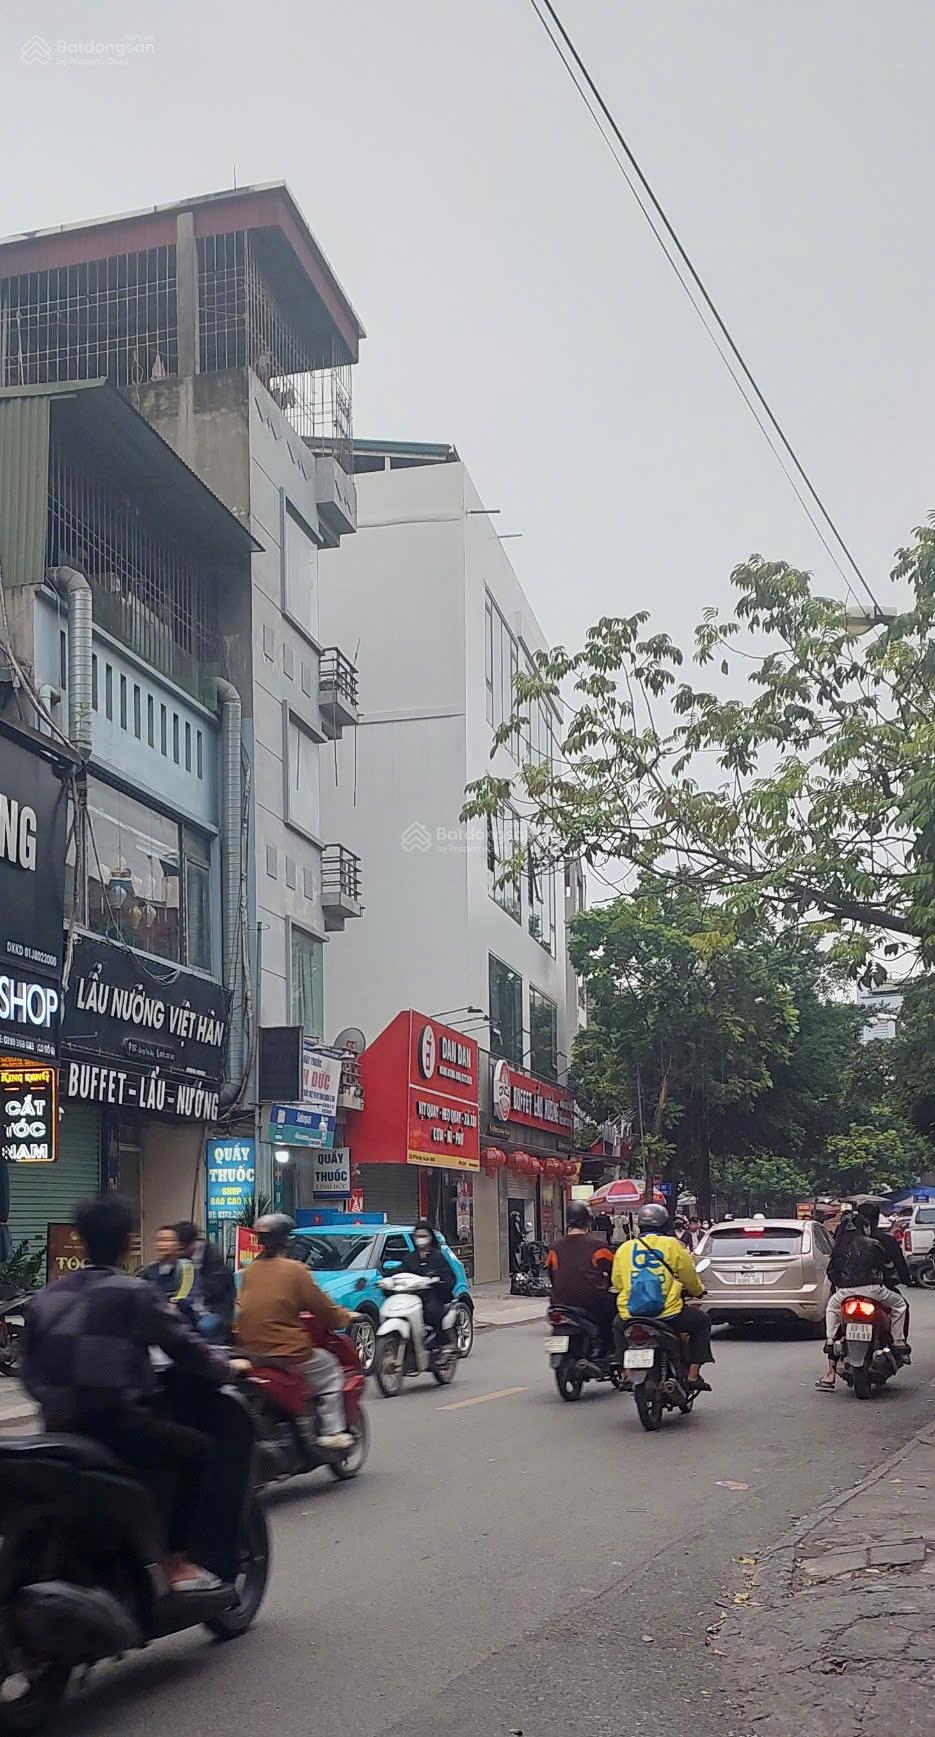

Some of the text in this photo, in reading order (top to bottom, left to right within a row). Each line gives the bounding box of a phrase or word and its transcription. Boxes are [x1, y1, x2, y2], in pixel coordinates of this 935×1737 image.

[0, 975, 58, 1028] SHOP
[77, 963, 225, 1048] LẨU NƯỚNG VIỆT HÀN
[68, 1063, 126, 1104] BUFFET
[139, 1066, 166, 1111] LẨU
[176, 1081, 219, 1121] NƯỚNG
[5, 1094, 46, 1116] CẮT
[2, 1144, 48, 1160] NAM
[209, 1163, 255, 1182] THUỐC
[315, 1168, 347, 1182] THUỐC
[633, 1243, 664, 1269] be
